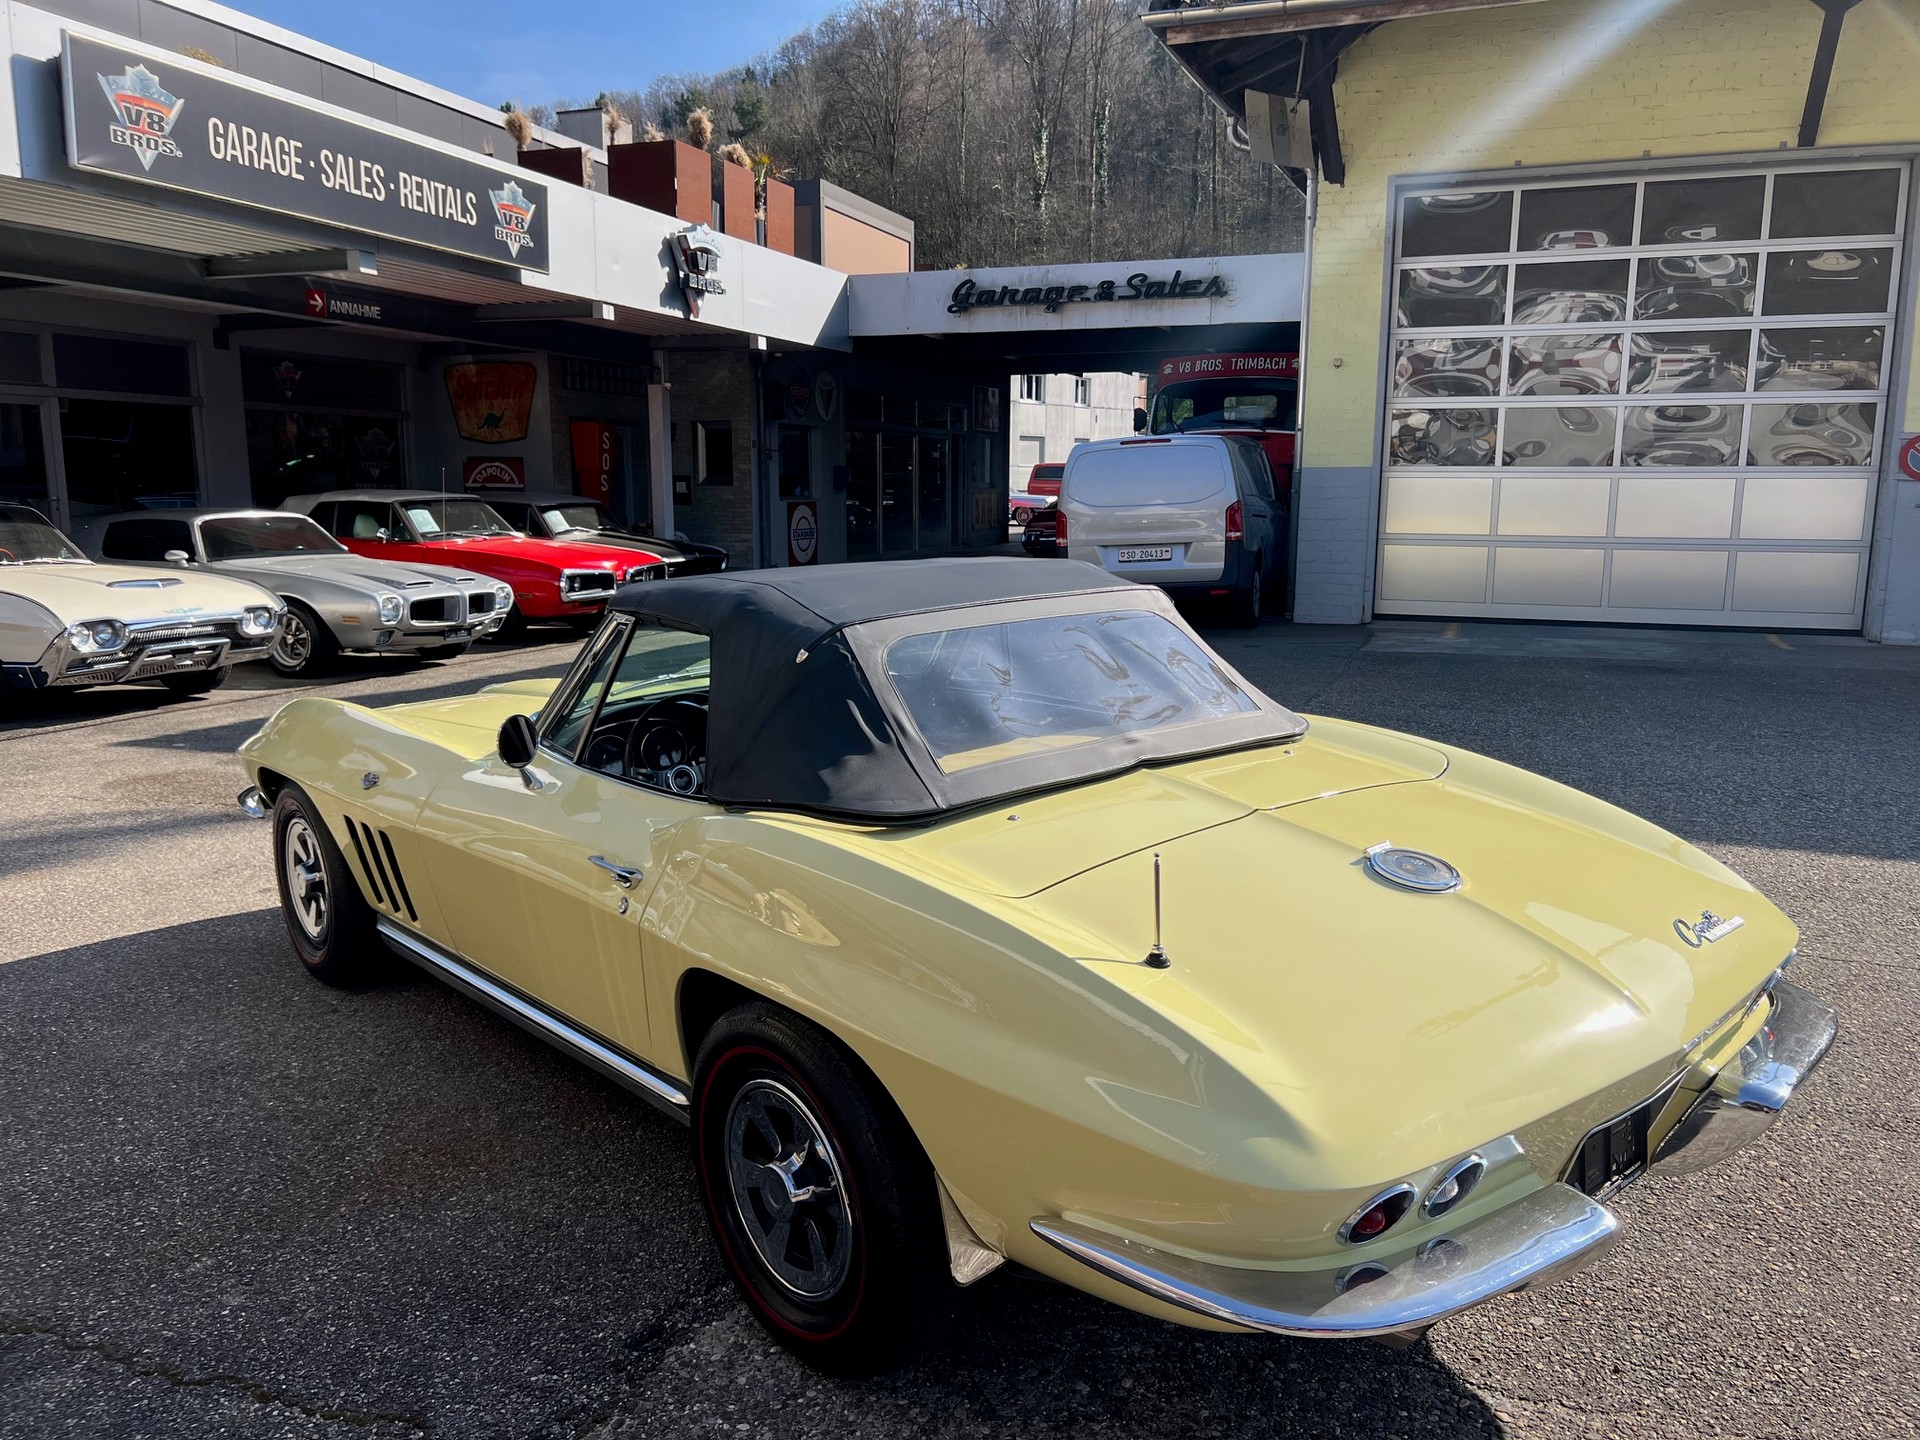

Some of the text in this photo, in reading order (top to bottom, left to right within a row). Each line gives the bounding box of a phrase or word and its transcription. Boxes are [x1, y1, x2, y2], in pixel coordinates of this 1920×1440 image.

[121, 103, 165, 133] V8
[110, 126, 183, 158] BROS.
[208, 117, 478, 226] GARAGE SALES RENTALS
[502, 211, 526, 231] V8
[495, 226, 534, 248] BROS.
[947, 270, 1229, 313] Garage & Sales
[330, 299, 381, 319] ANNAHME
[1179, 361, 1191, 373] V8
[1195, 359, 1225, 372] BROS.
[1231, 357, 1287, 370] TRIMBACH
[475, 466, 513, 483] DAPOLIN
[600, 431, 610, 492] SOS
